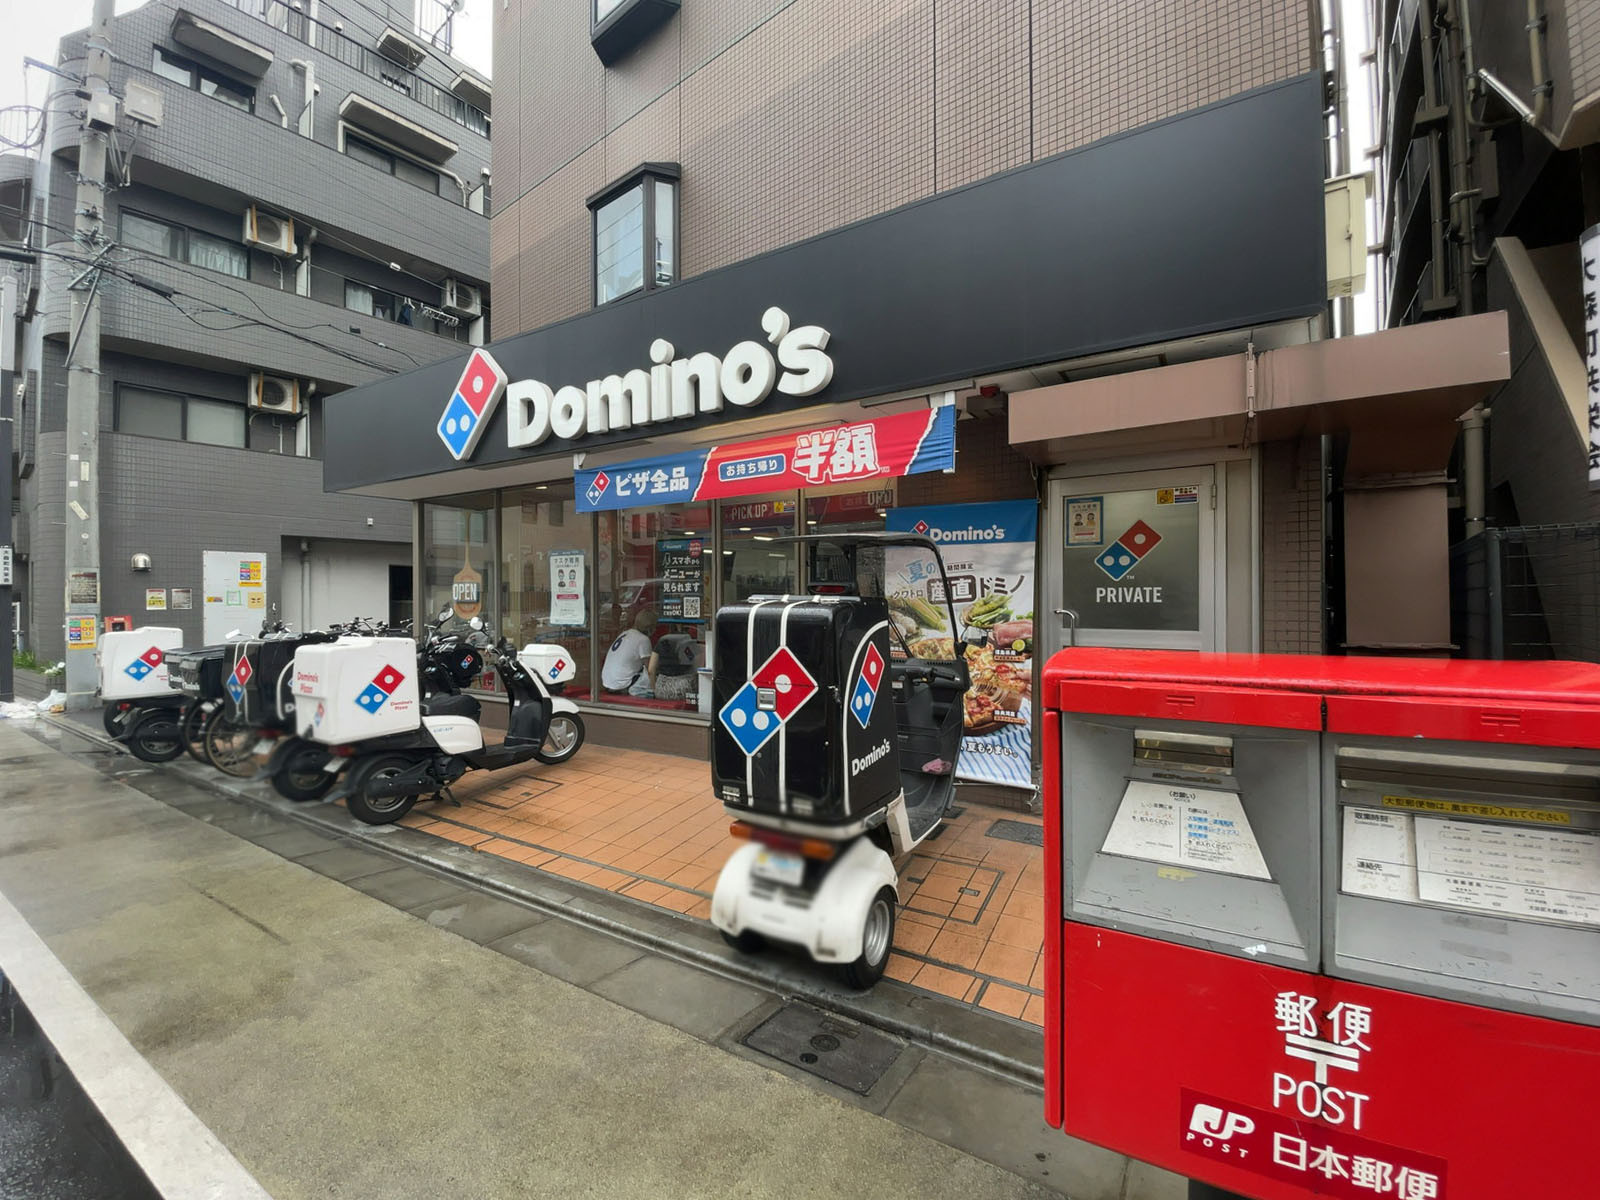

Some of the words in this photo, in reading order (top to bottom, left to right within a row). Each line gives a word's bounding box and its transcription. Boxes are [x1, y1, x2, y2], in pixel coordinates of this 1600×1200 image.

[507, 306, 833, 448] Domino's
[793, 424, 879, 483] 半額
[615, 466, 689, 496] ピザ全品
[726, 458, 779, 477] お持ち帰り
[731, 504, 753, 520] PICK
[755, 503, 767, 518] UP
[929, 524, 1005, 542] Domino's
[663, 569, 700, 579] メニューが
[663, 582, 700, 593] 見られます
[452, 583, 478, 601] OPEN
[1096, 587, 1162, 603] PRIVATE
[852, 738, 891, 776] Domino's
[1274, 991, 1372, 1051] 郵便
[1273, 1072, 1370, 1130] POST
[1186, 1131, 1249, 1158] POST
[1273, 1131, 1439, 1200] 日本郵便
